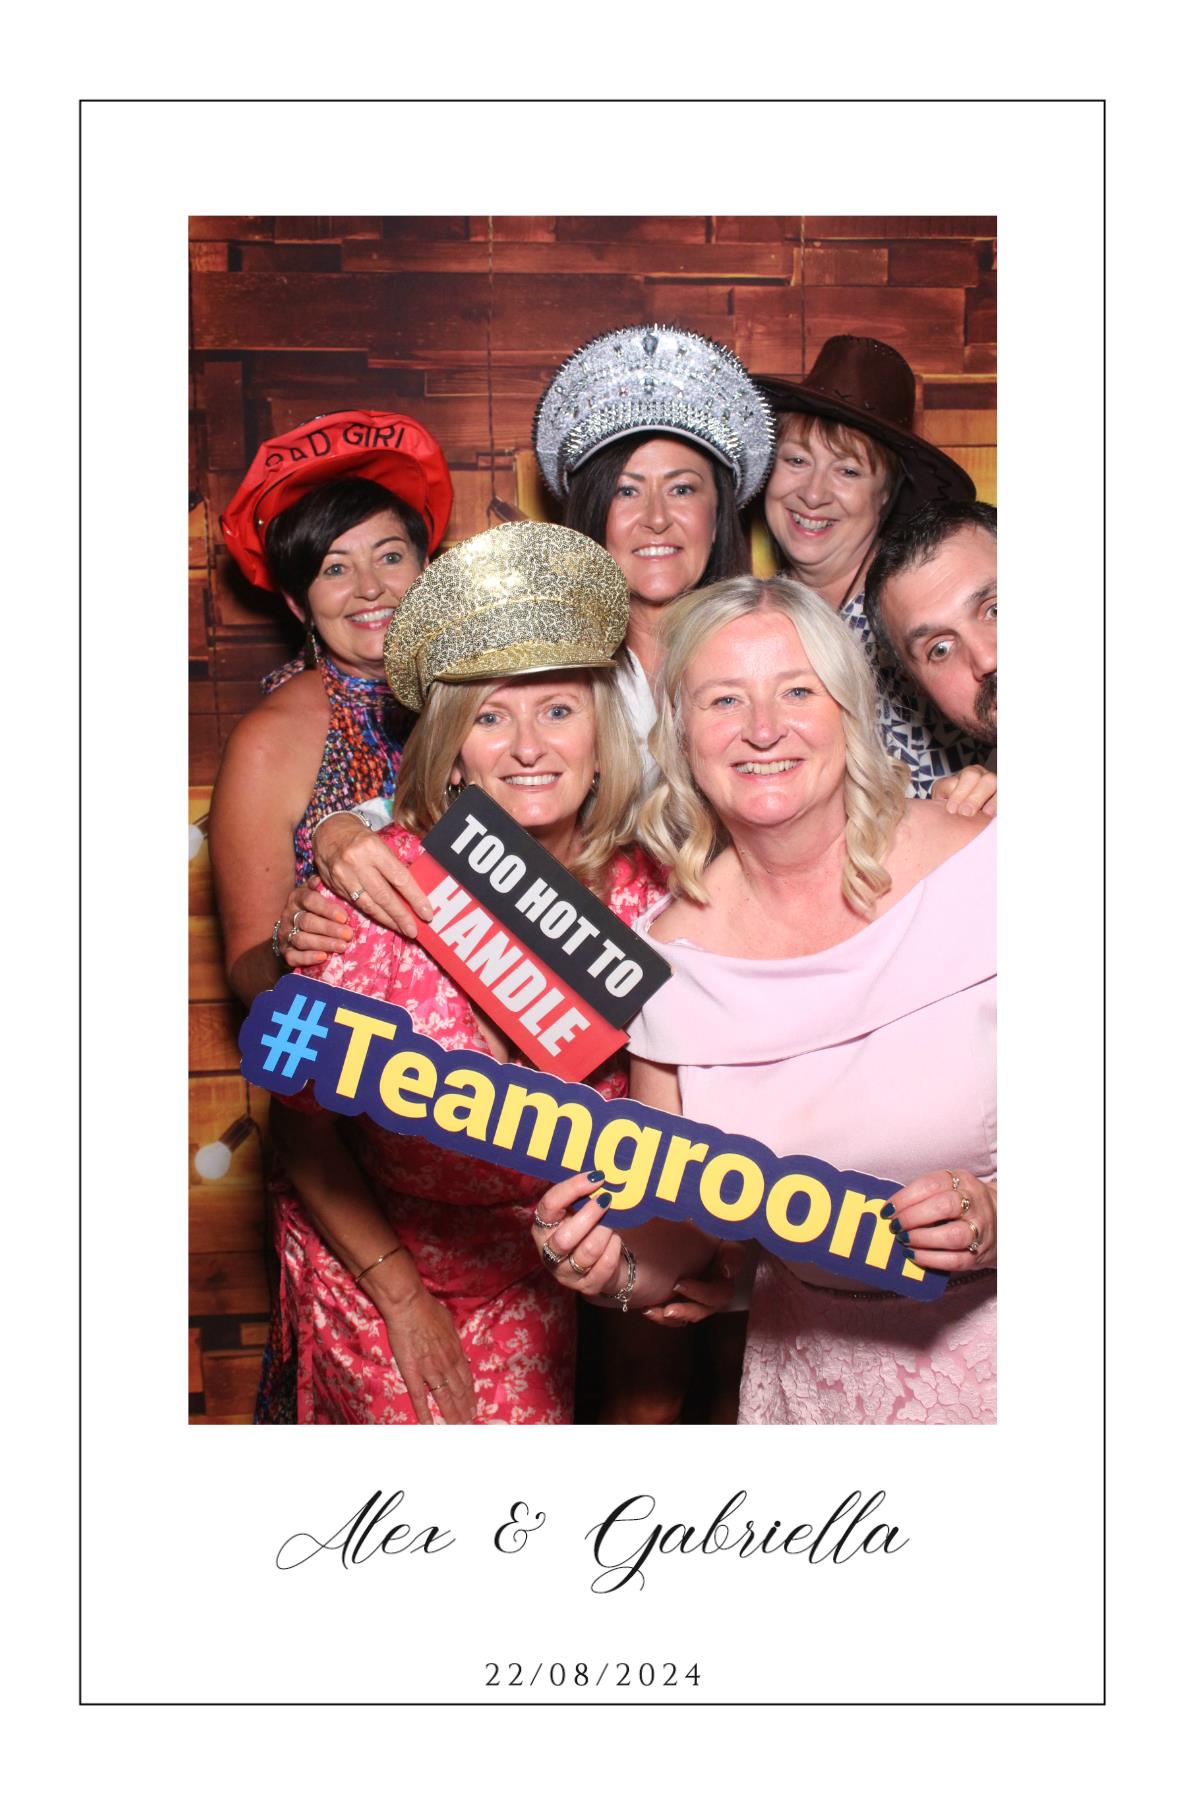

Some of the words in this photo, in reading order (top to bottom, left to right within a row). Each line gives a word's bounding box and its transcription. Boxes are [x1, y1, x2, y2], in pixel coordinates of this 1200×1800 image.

[427, 875, 591, 1057] HANDLE
[450, 814, 527, 893] TOO
[514, 877, 600, 956] HOT
[586, 939, 644, 998] TO
[261, 993, 926, 1282] #Teamgroom
